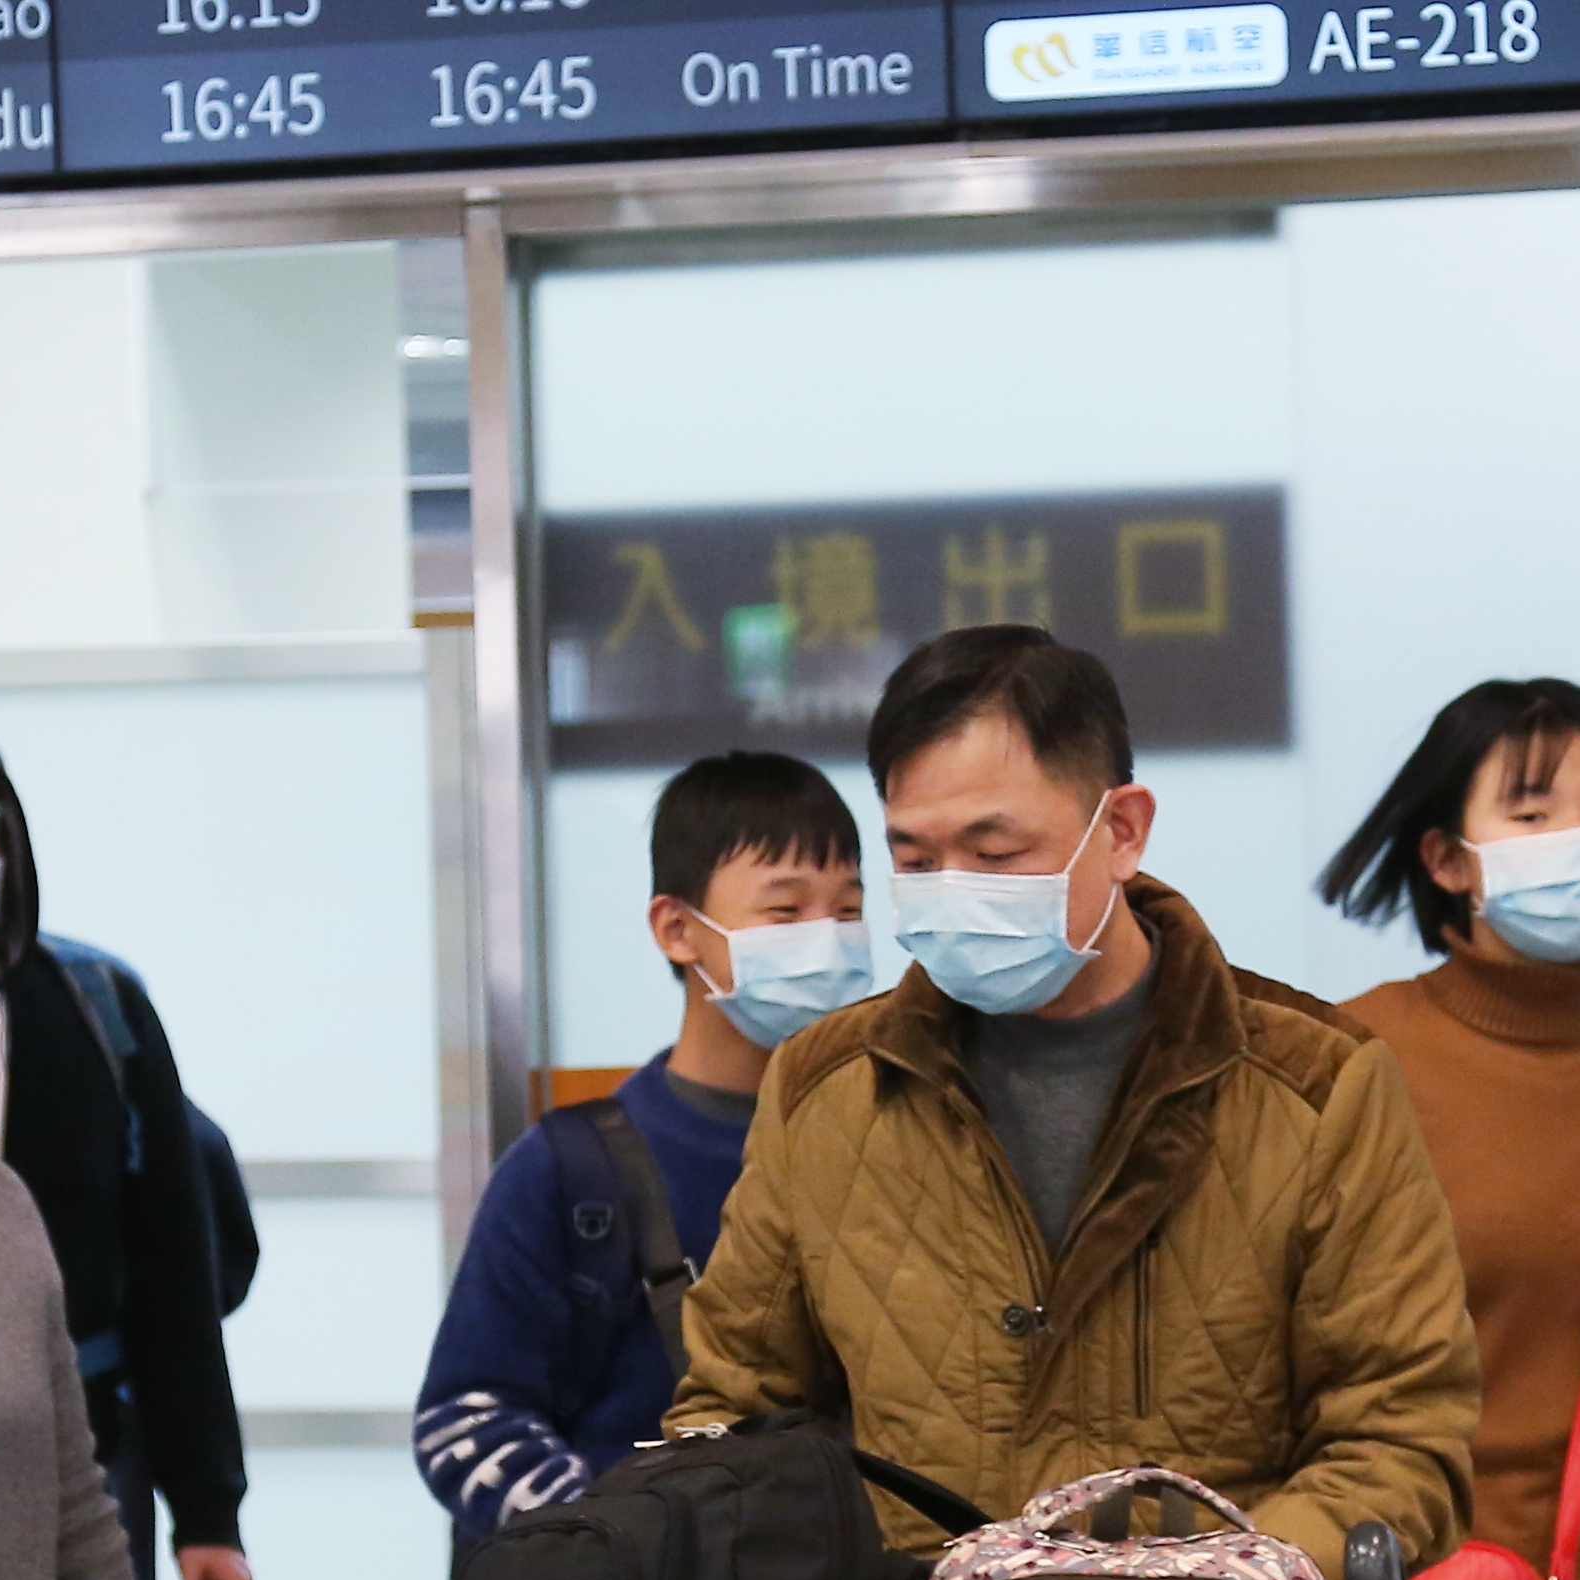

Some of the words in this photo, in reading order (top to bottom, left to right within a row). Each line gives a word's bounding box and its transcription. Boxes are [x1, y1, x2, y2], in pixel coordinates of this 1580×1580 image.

[1309, 1, 1541, 74] AE-218
[161, 72, 325, 143] 16:45
[430, 56, 597, 128] 16:45
[682, 52, 760, 107] On
[773, 44, 914, 98] Time
